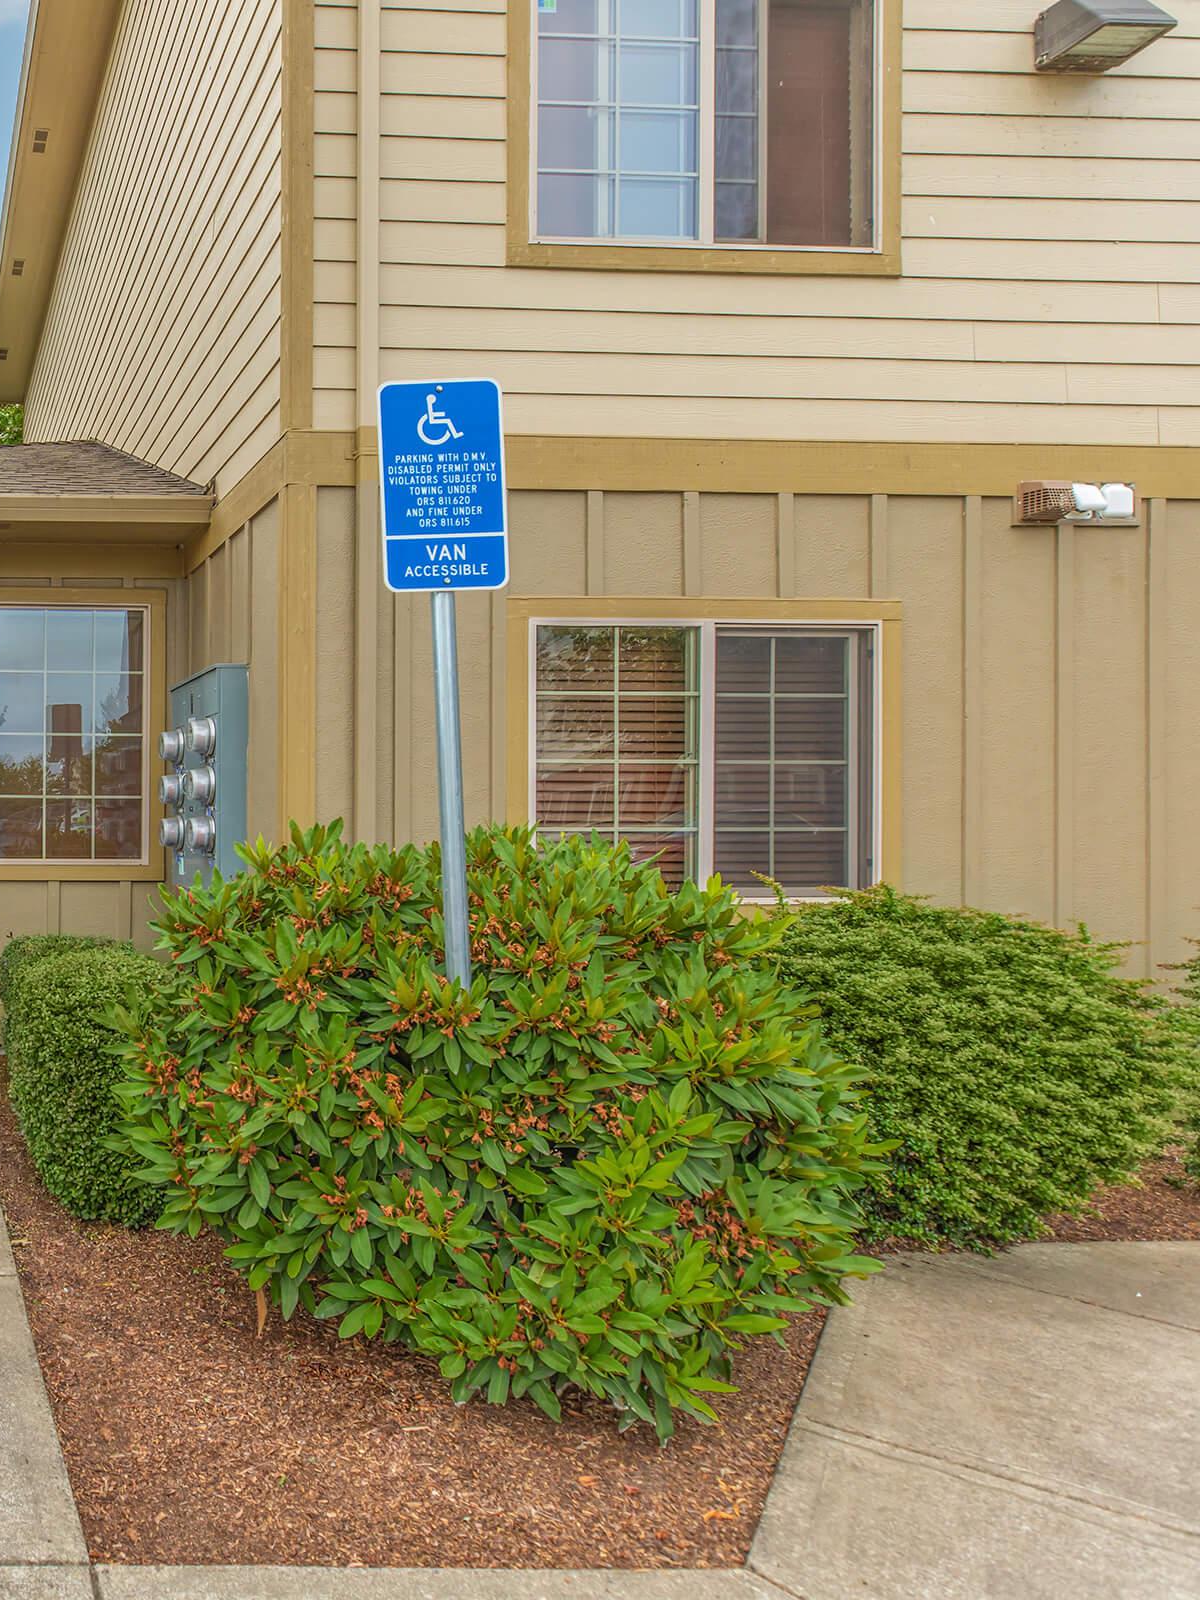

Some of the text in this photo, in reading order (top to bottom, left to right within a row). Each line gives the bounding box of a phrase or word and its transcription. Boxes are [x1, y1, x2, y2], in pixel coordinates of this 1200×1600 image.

[395, 454, 434, 463] PARKING
[437, 453, 459, 462] WITH
[388, 462, 496, 475] DISABLED PERMIT ONLY
[389, 473, 497, 485] VIOLATORS SUBJECT TO
[410, 485, 478, 496] TOWING UNDER
[417, 497, 435, 506] ORS
[406, 506, 482, 517] AND FINE UNDER
[419, 518, 437, 528] ORS
[426, 544, 466, 561] VAN
[405, 563, 489, 578] ACCESSIBLE
